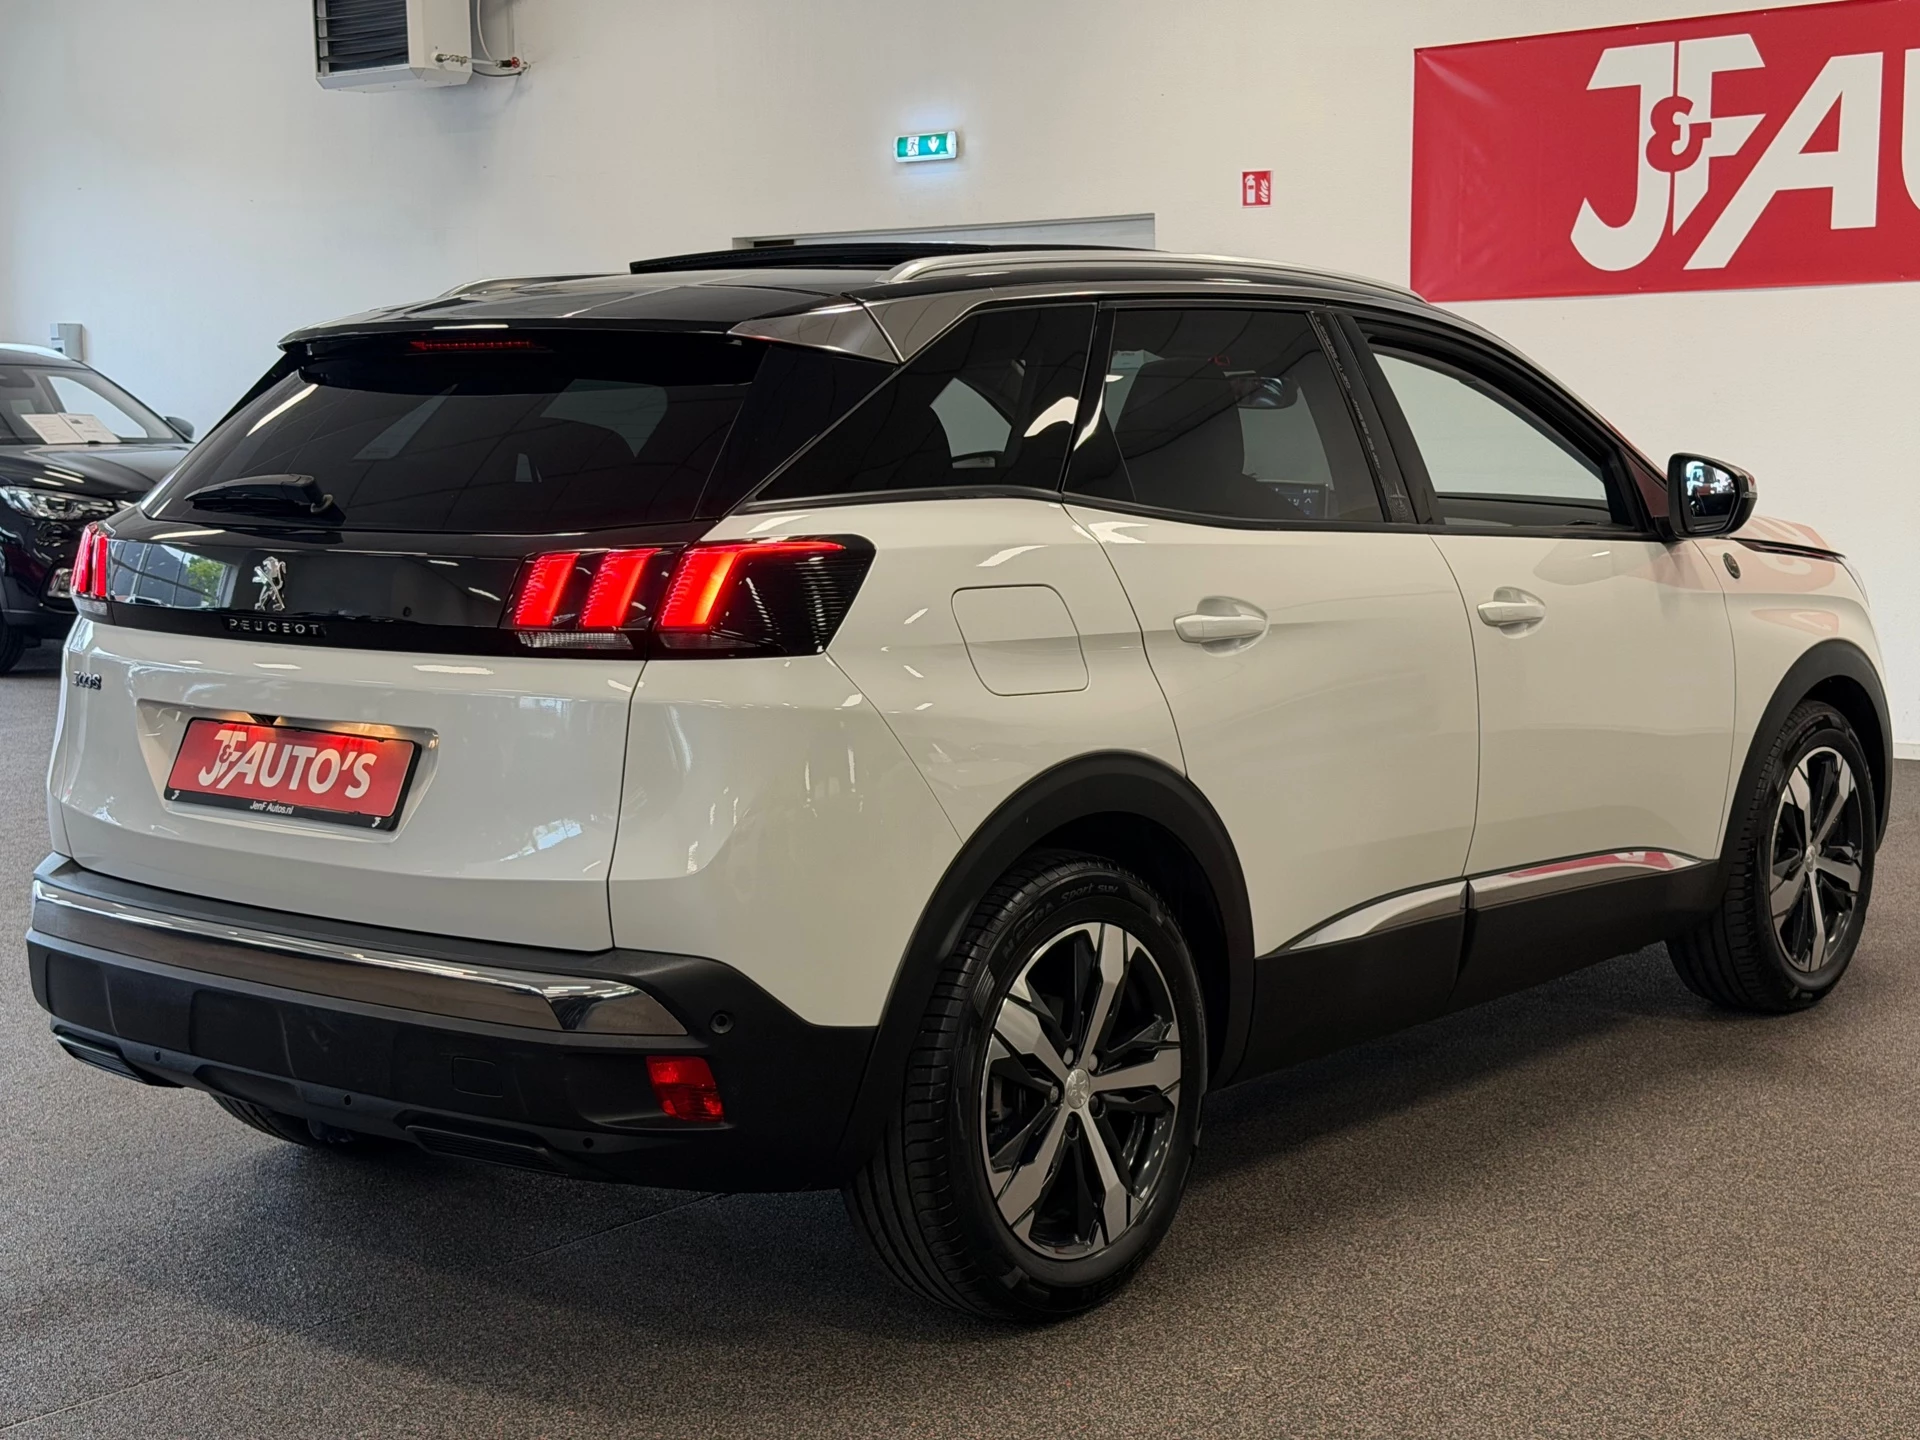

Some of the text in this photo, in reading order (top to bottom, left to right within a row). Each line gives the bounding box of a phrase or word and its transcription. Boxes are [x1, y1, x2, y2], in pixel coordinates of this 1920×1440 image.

[229, 618, 319, 636] PEUGEOT
[216, 741, 377, 799] AUTO'S
[249, 801, 295, 815] JenF Autos.nl
